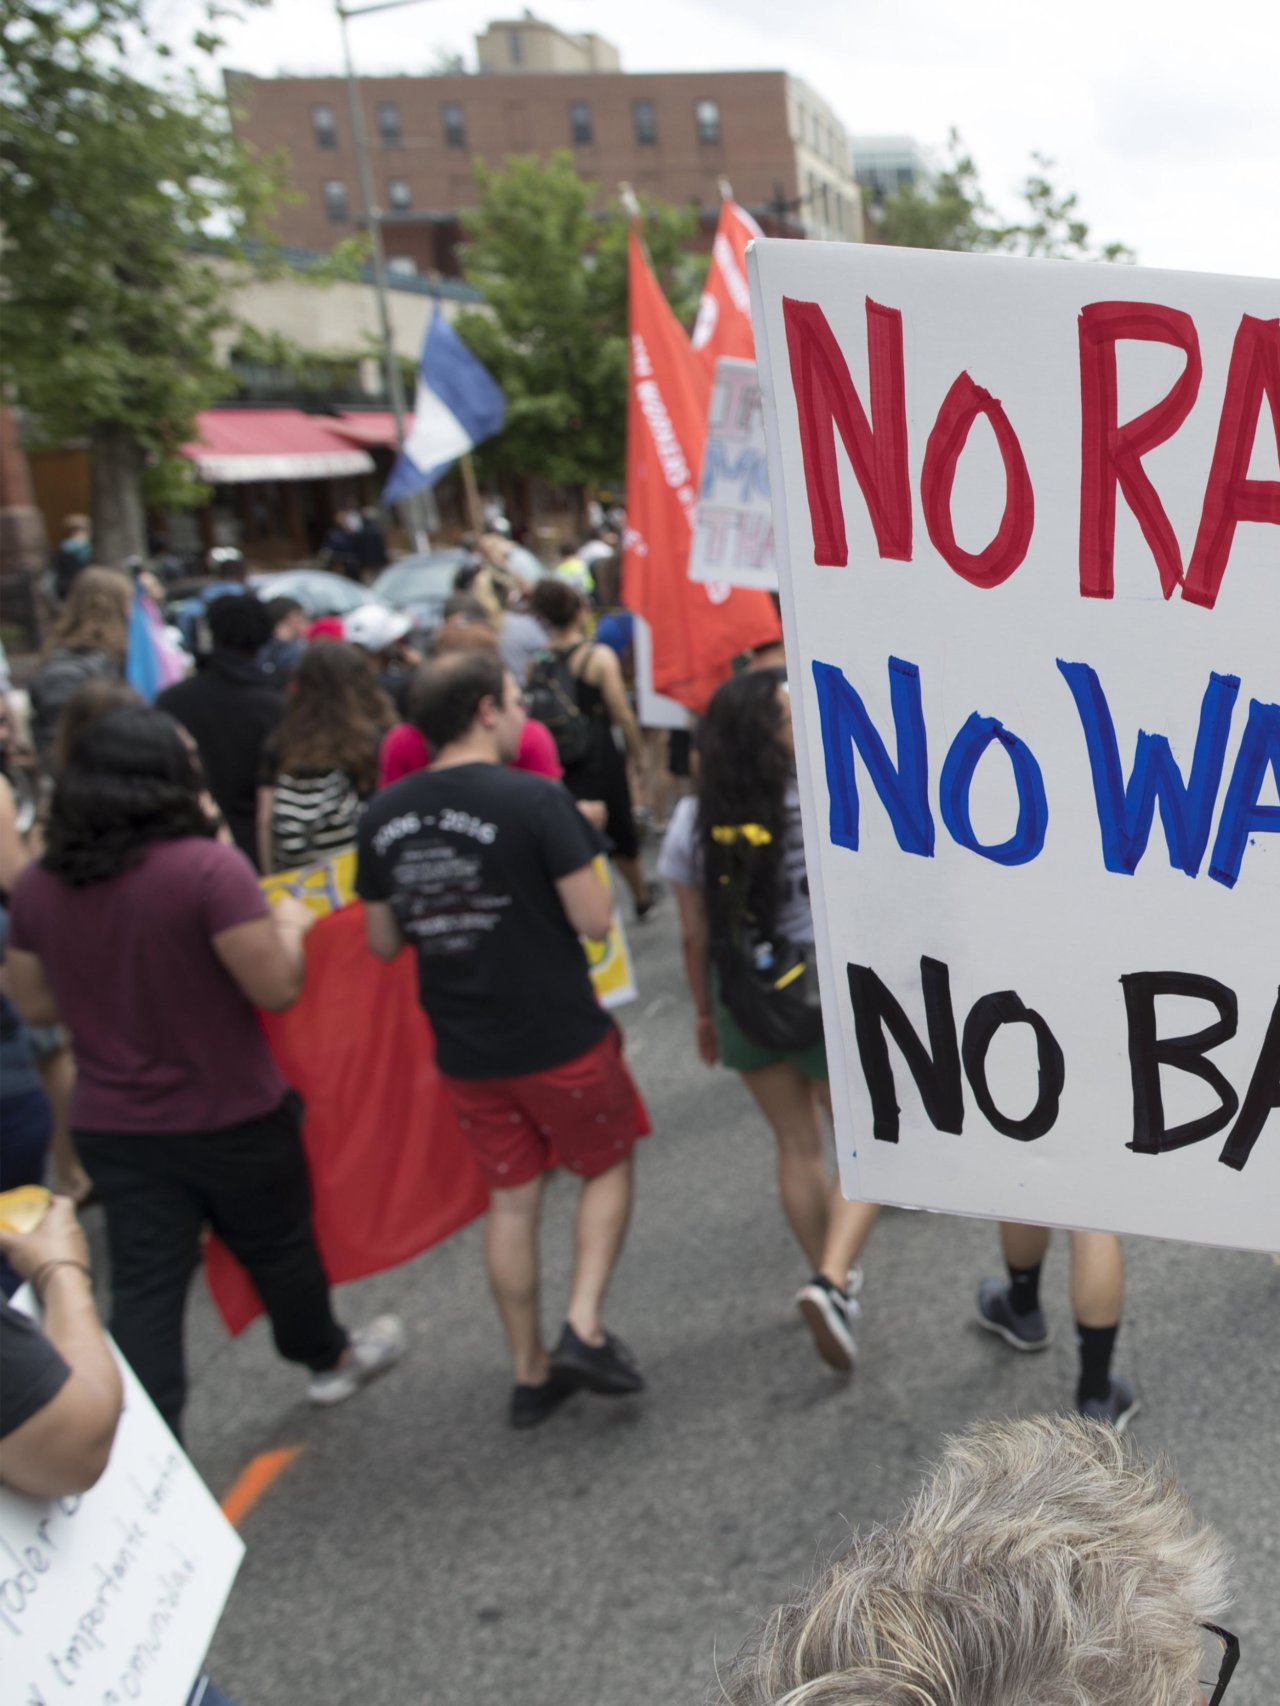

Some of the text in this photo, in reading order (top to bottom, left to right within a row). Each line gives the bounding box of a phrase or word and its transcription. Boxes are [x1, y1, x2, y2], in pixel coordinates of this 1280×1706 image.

[783, 298, 1034, 588] NO
[438, 808, 498, 846] 2016
[811, 656, 1048, 866] NO
[847, 955, 1064, 1143] NO
